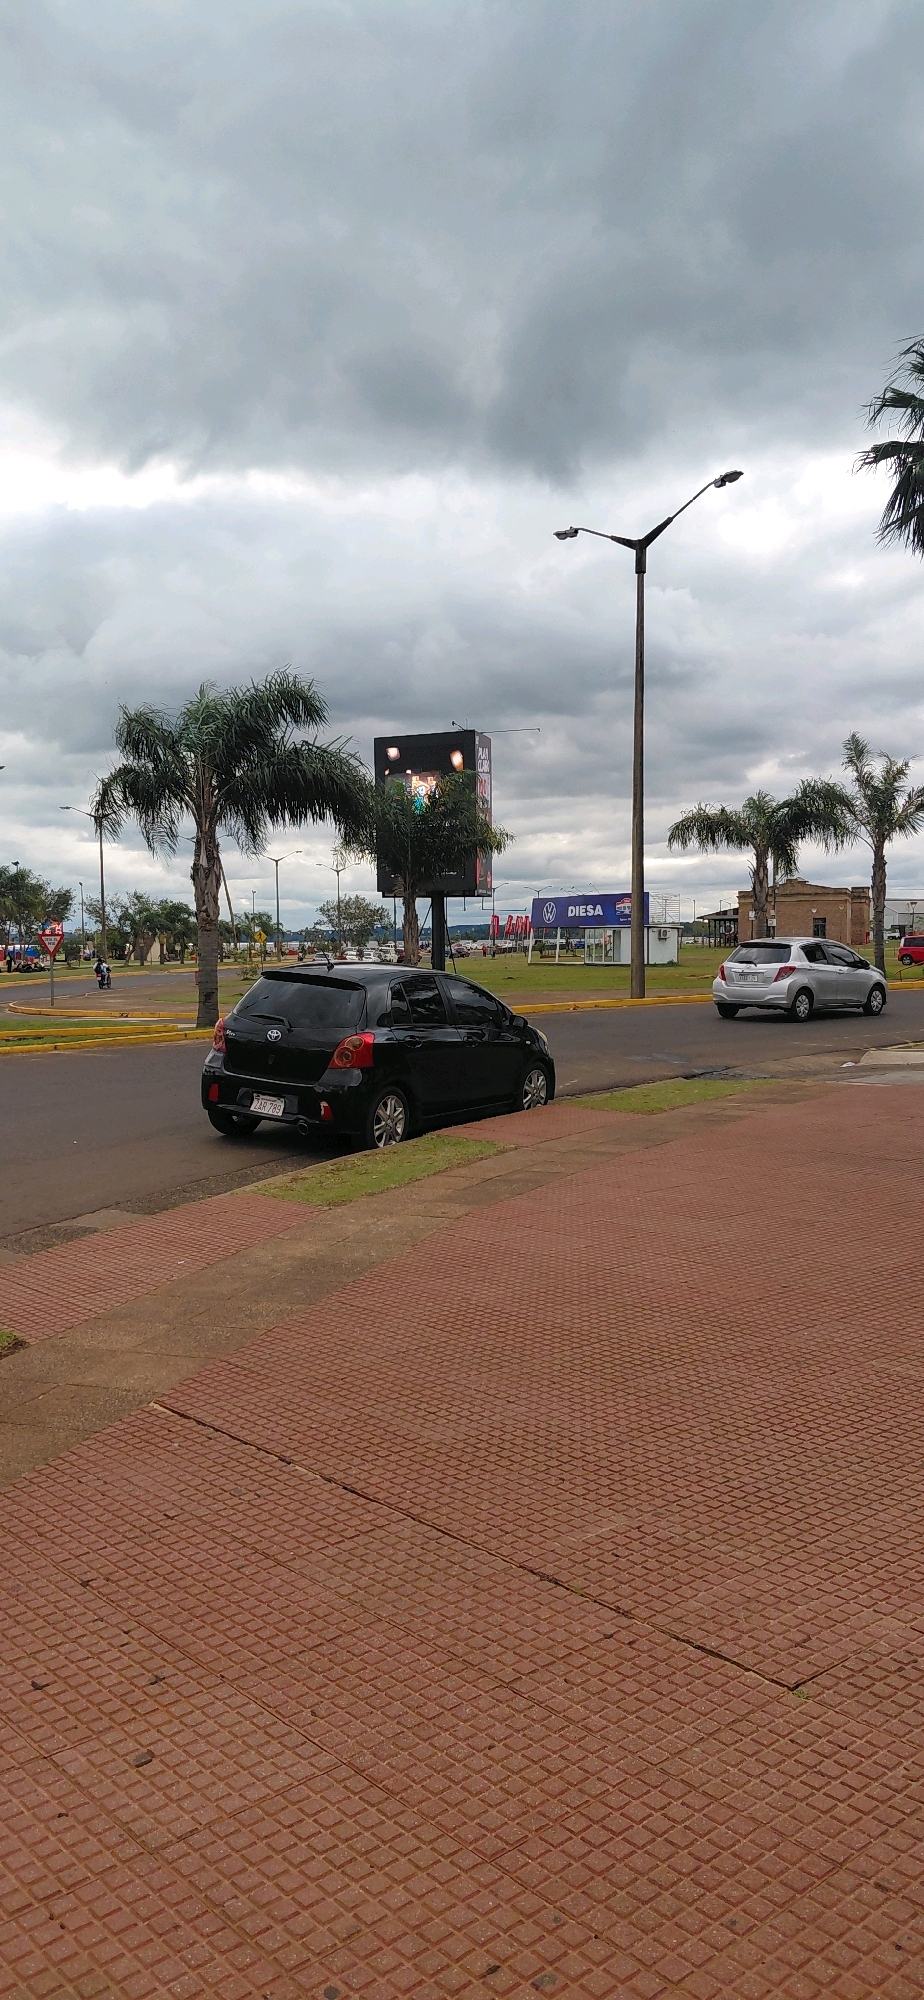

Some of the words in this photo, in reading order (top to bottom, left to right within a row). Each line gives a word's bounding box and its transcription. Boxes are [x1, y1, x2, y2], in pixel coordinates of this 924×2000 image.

[567, 904, 603, 917] DIESA
[254, 1100, 267, 1111] ZAR
[268, 1102, 281, 1114] 789
